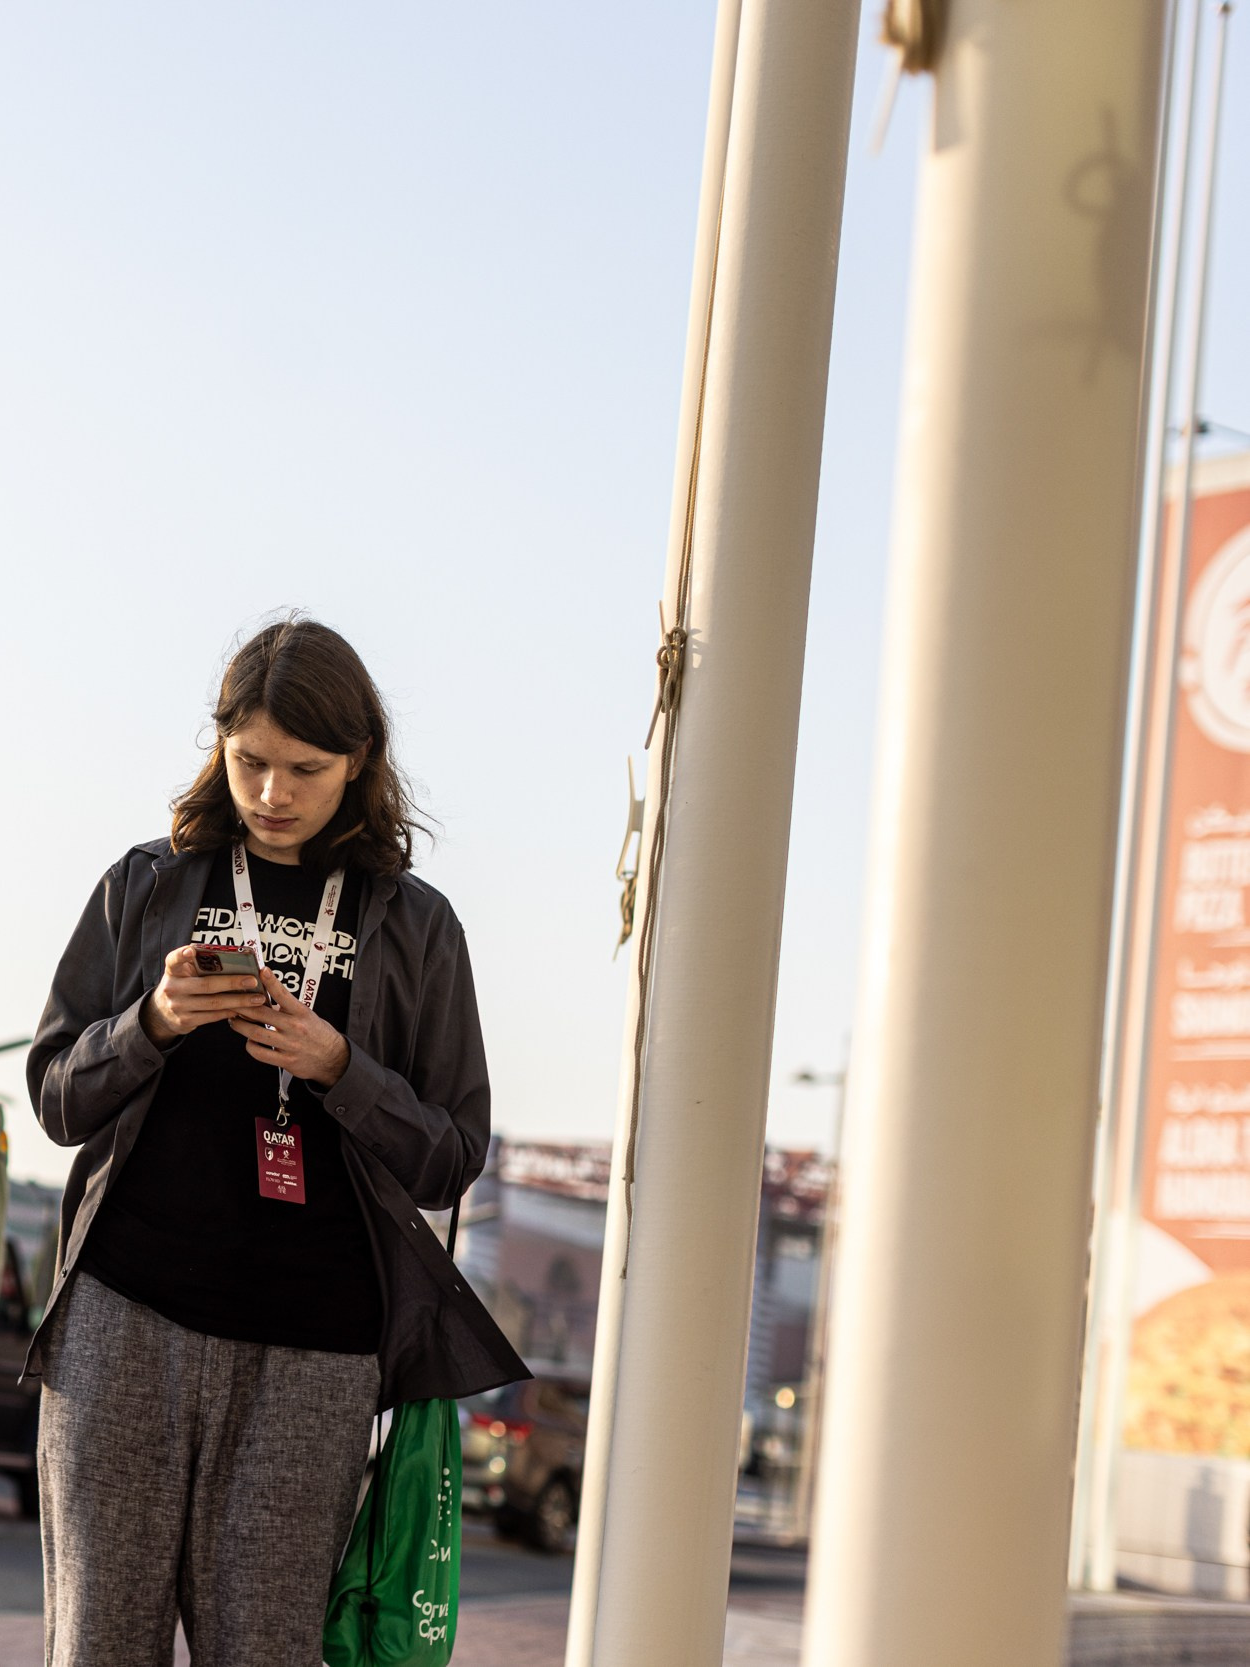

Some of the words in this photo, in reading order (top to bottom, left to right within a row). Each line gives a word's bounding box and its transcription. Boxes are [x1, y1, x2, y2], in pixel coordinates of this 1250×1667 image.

[234, 847, 245, 875] QATAR
[303, 978, 317, 1008] QATAR
[263, 1130, 295, 1147] QATAR
